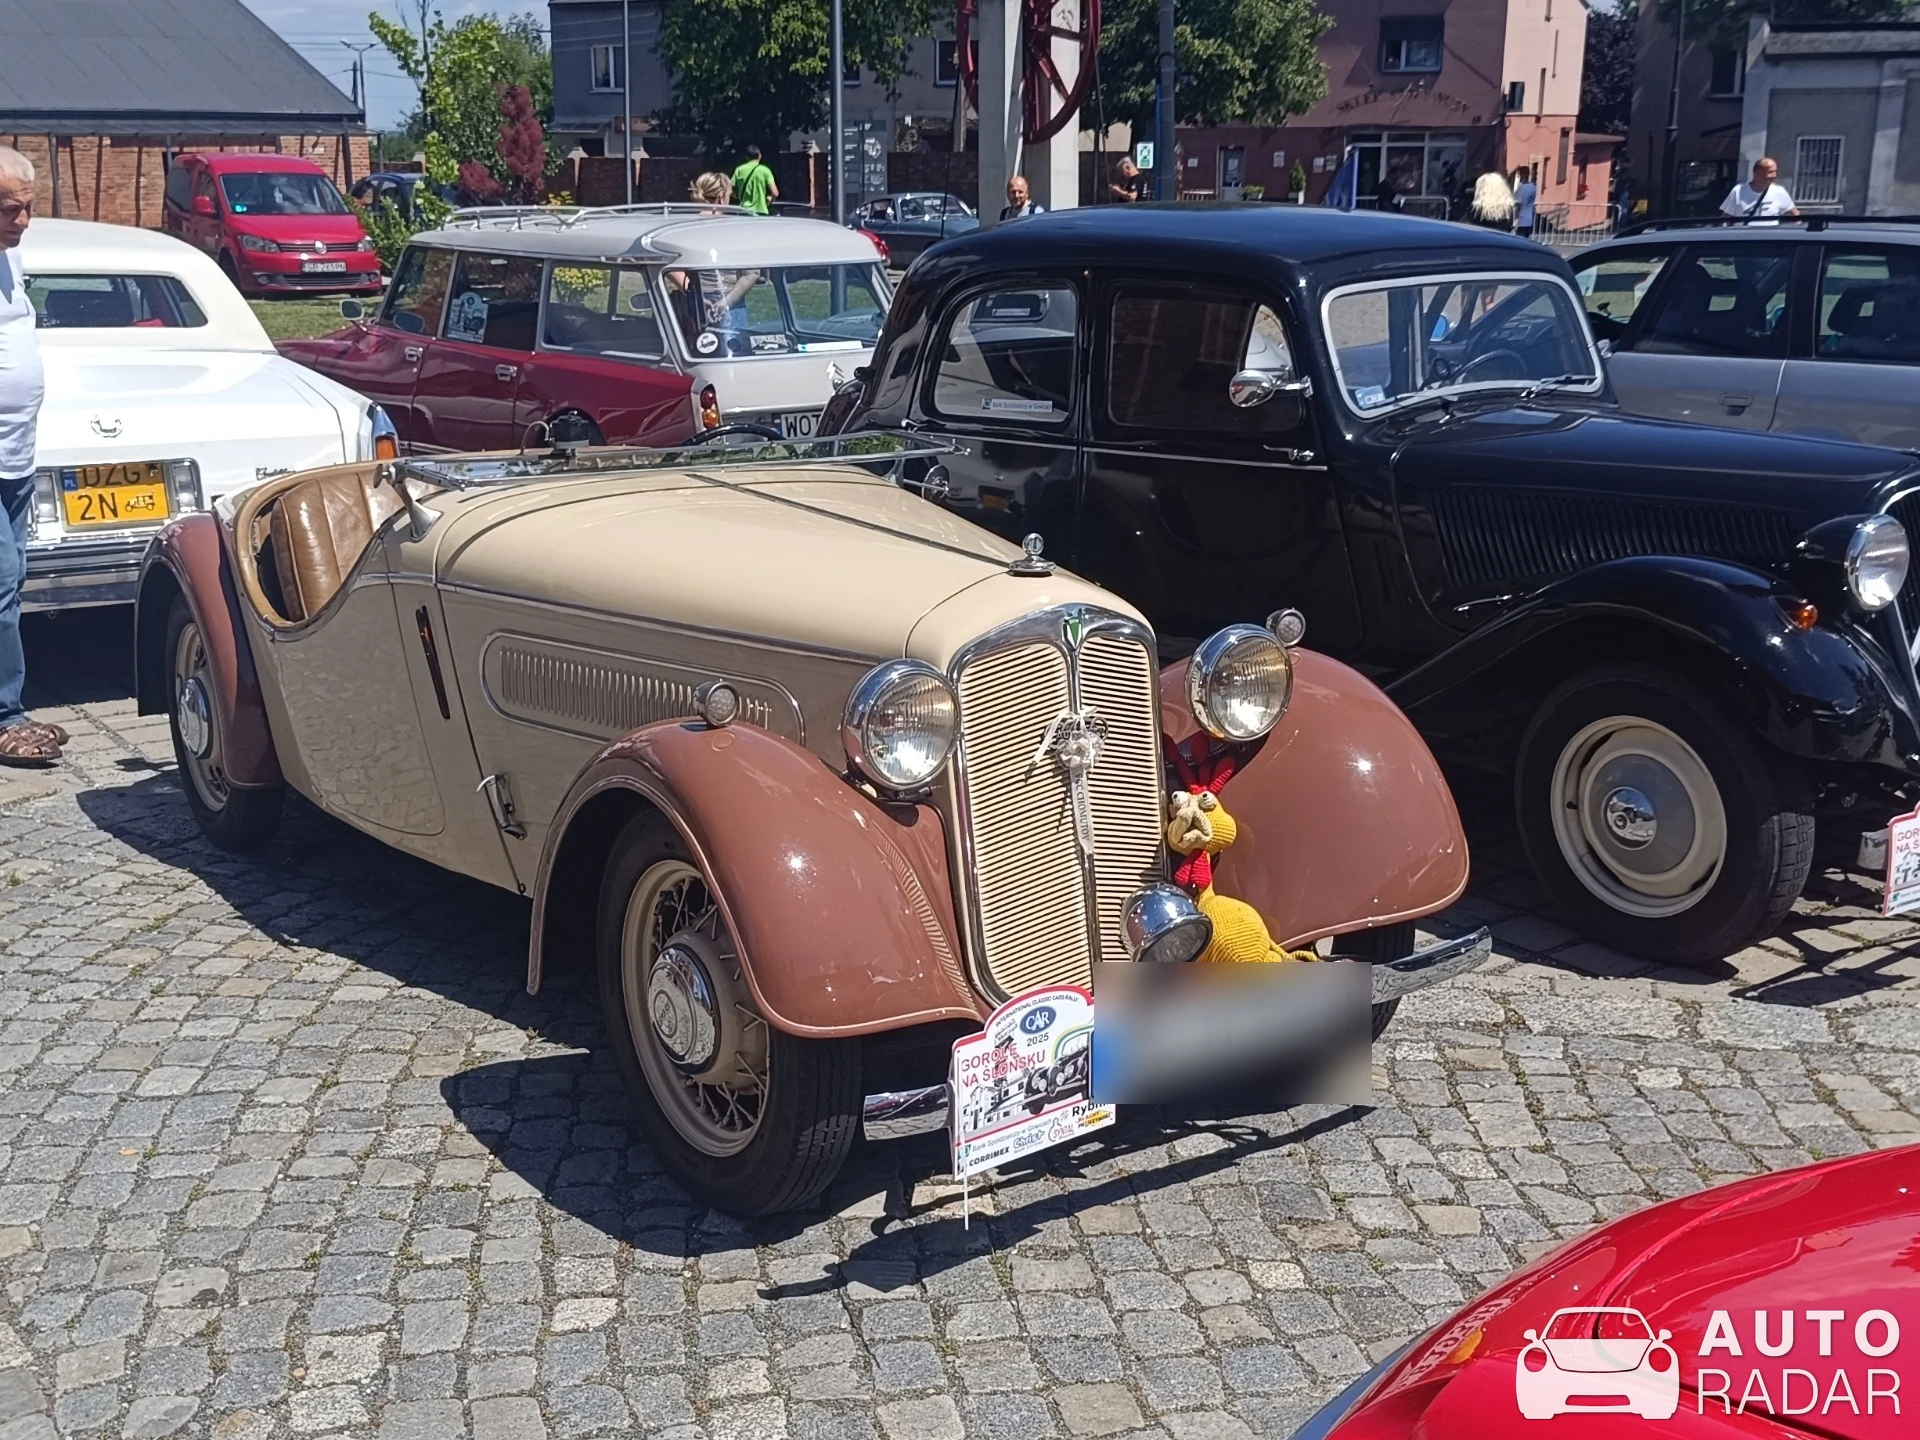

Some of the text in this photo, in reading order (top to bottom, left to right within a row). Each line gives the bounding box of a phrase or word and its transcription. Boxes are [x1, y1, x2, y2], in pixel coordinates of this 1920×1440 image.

[77, 491, 119, 521] 2N
[995, 1002, 1032, 1028] INTERNATIONAL
[1032, 996, 1052, 1007] CLASSIC
[1065, 994, 1080, 1003] RALLY
[1025, 1009, 1051, 1032] CAR
[1026, 1032, 1050, 1047] 2025
[972, 1142, 986, 1152] Bank
[1013, 1130, 1046, 1149] Christ
[969, 1146, 1010, 1167] CORRIMEX
